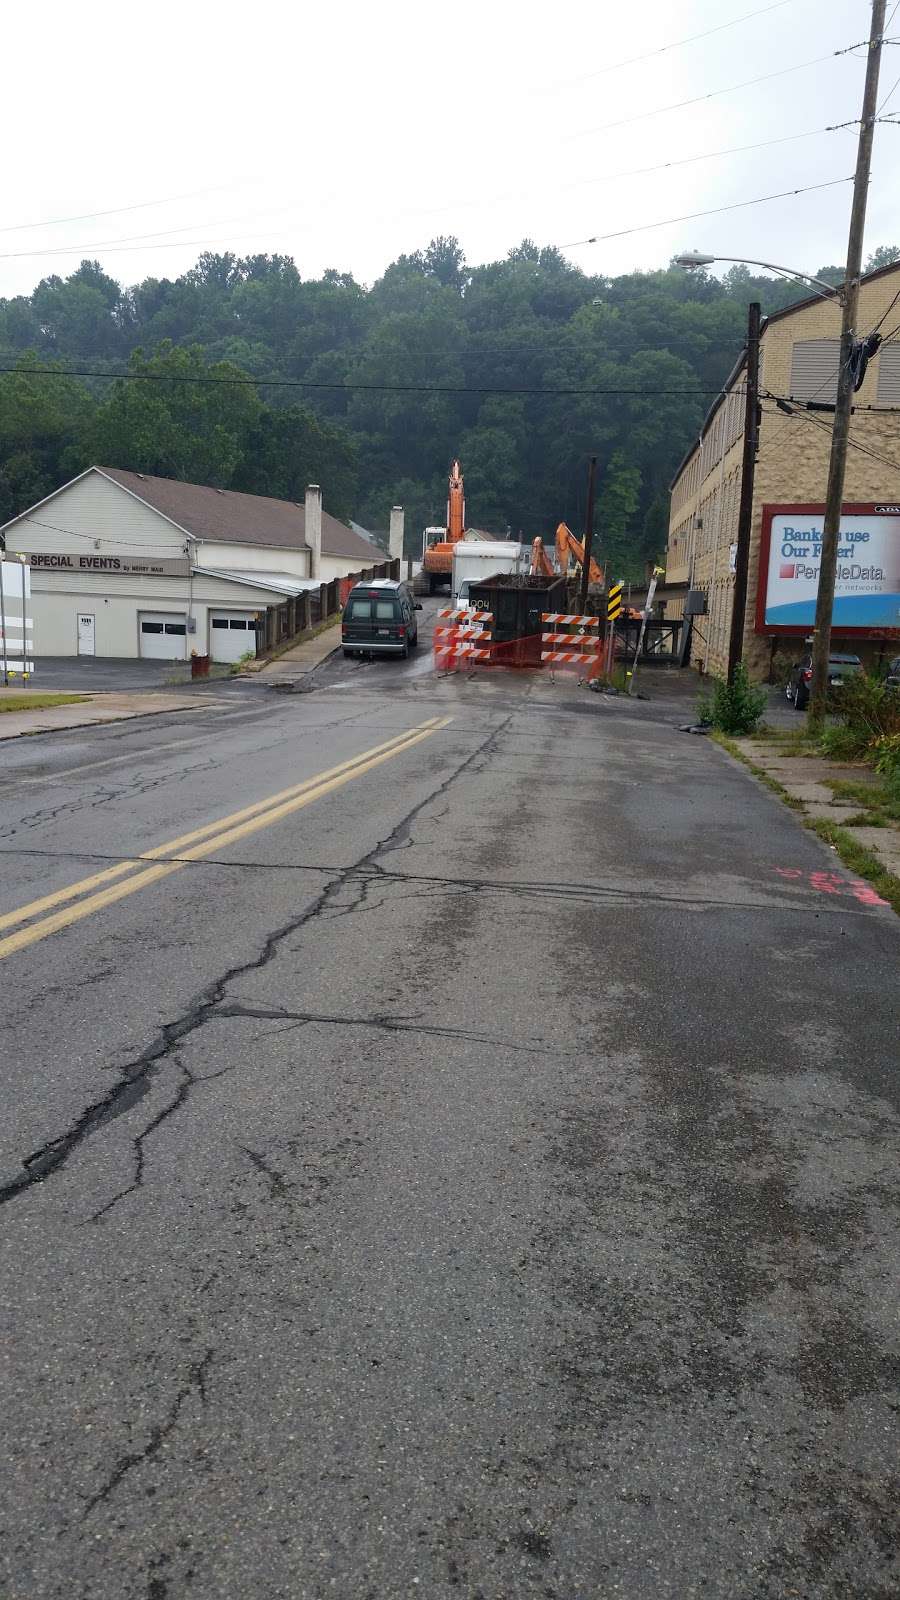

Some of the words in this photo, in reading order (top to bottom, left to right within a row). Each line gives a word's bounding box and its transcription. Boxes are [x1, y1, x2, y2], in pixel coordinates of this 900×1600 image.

[783, 527, 842, 542] Banks
[845, 531, 870, 542] use
[781, 543, 809, 557] Our
[812, 543, 855, 558] Fer!
[30, 555, 73, 567] SPECIAL
[79, 557, 120, 569] EVENTS
